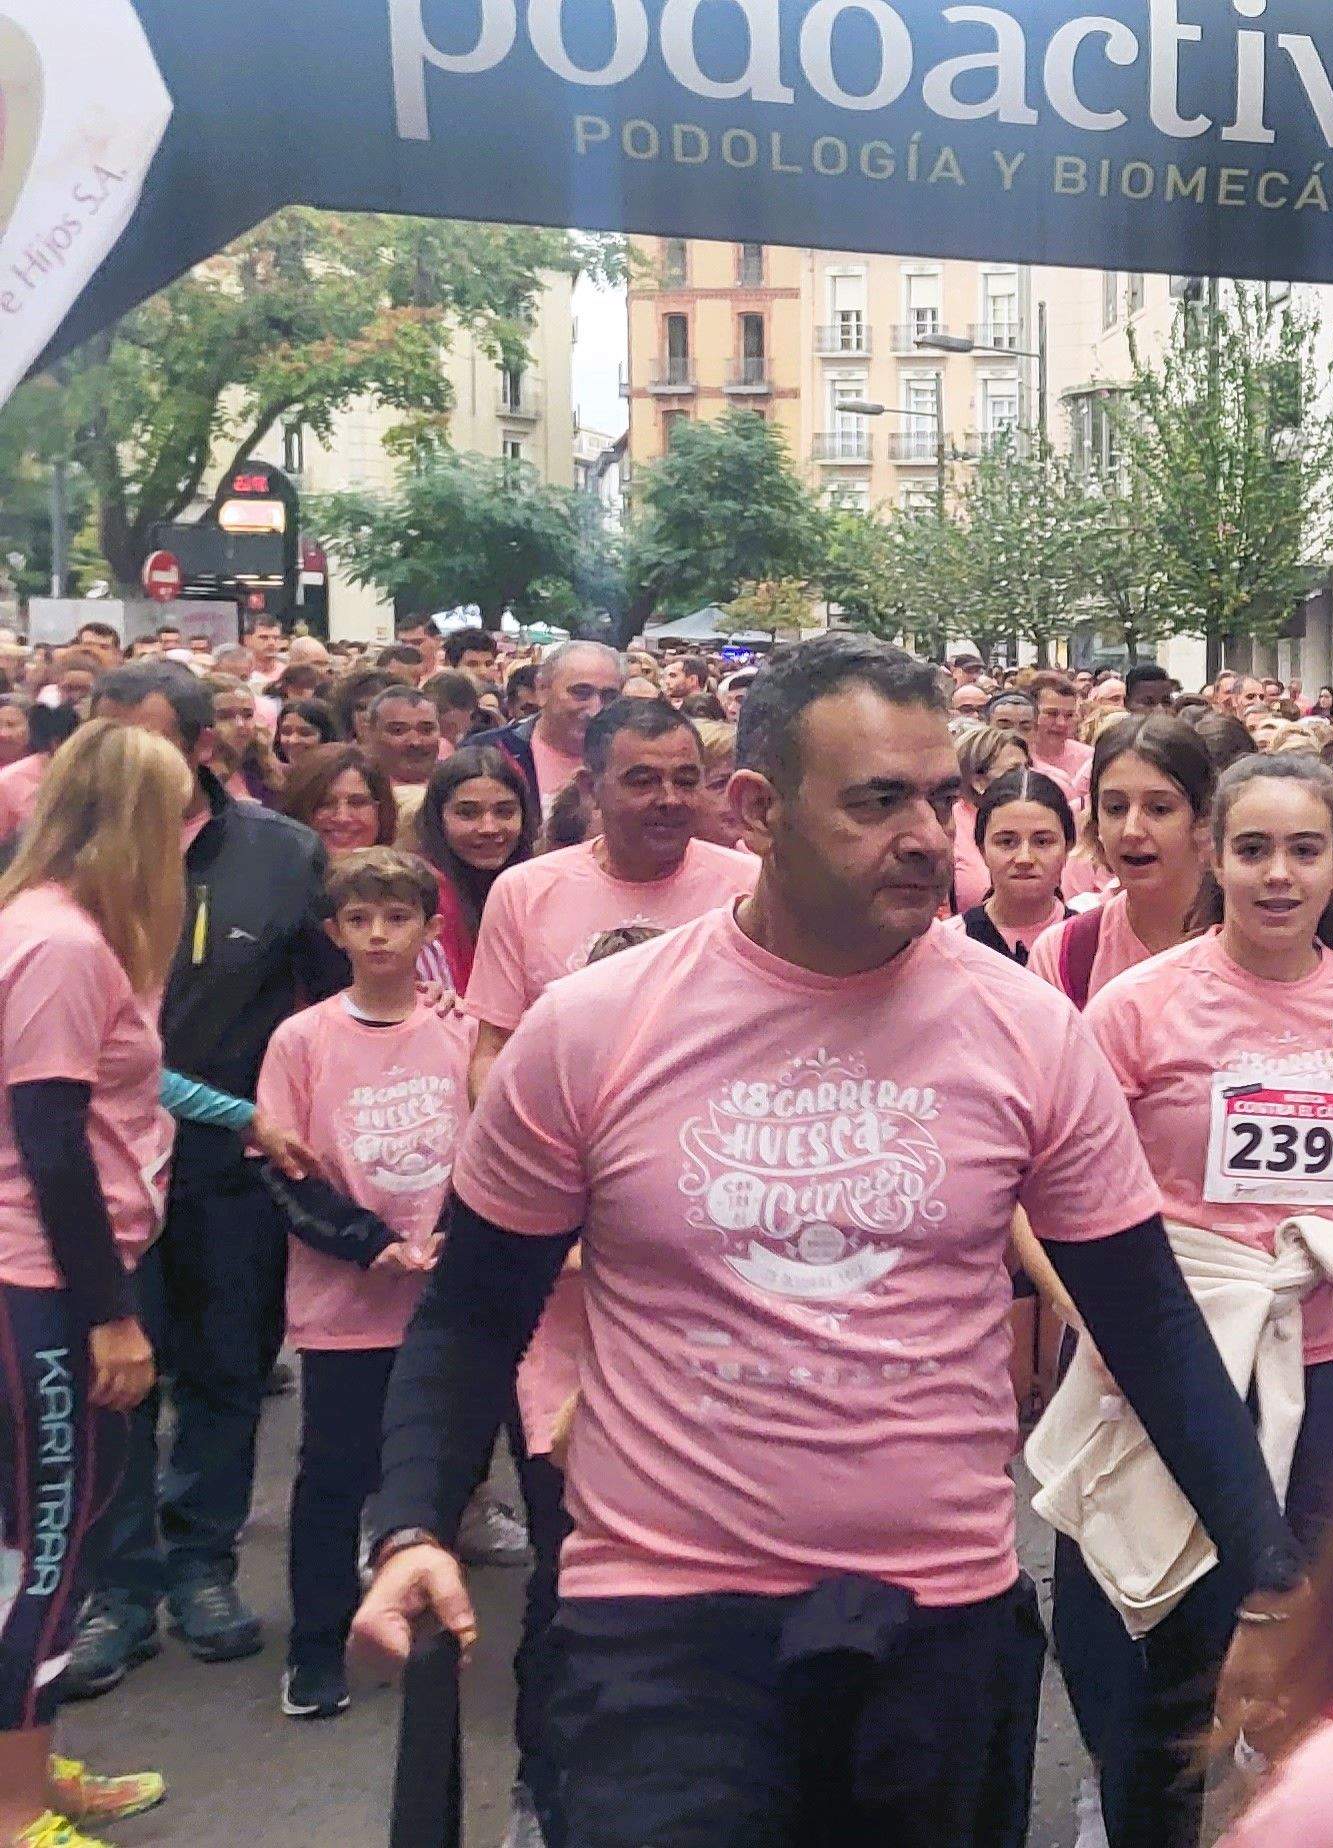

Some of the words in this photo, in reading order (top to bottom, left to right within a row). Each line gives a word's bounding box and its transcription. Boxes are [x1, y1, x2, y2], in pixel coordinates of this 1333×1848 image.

[574, 113, 966, 187] PODOLOGÍA
[994, 149, 1026, 191] Y
[11, 212, 82, 288] Hijos
[35, 1347, 74, 1465] KARI
[26, 1467, 73, 1597] TRAA
